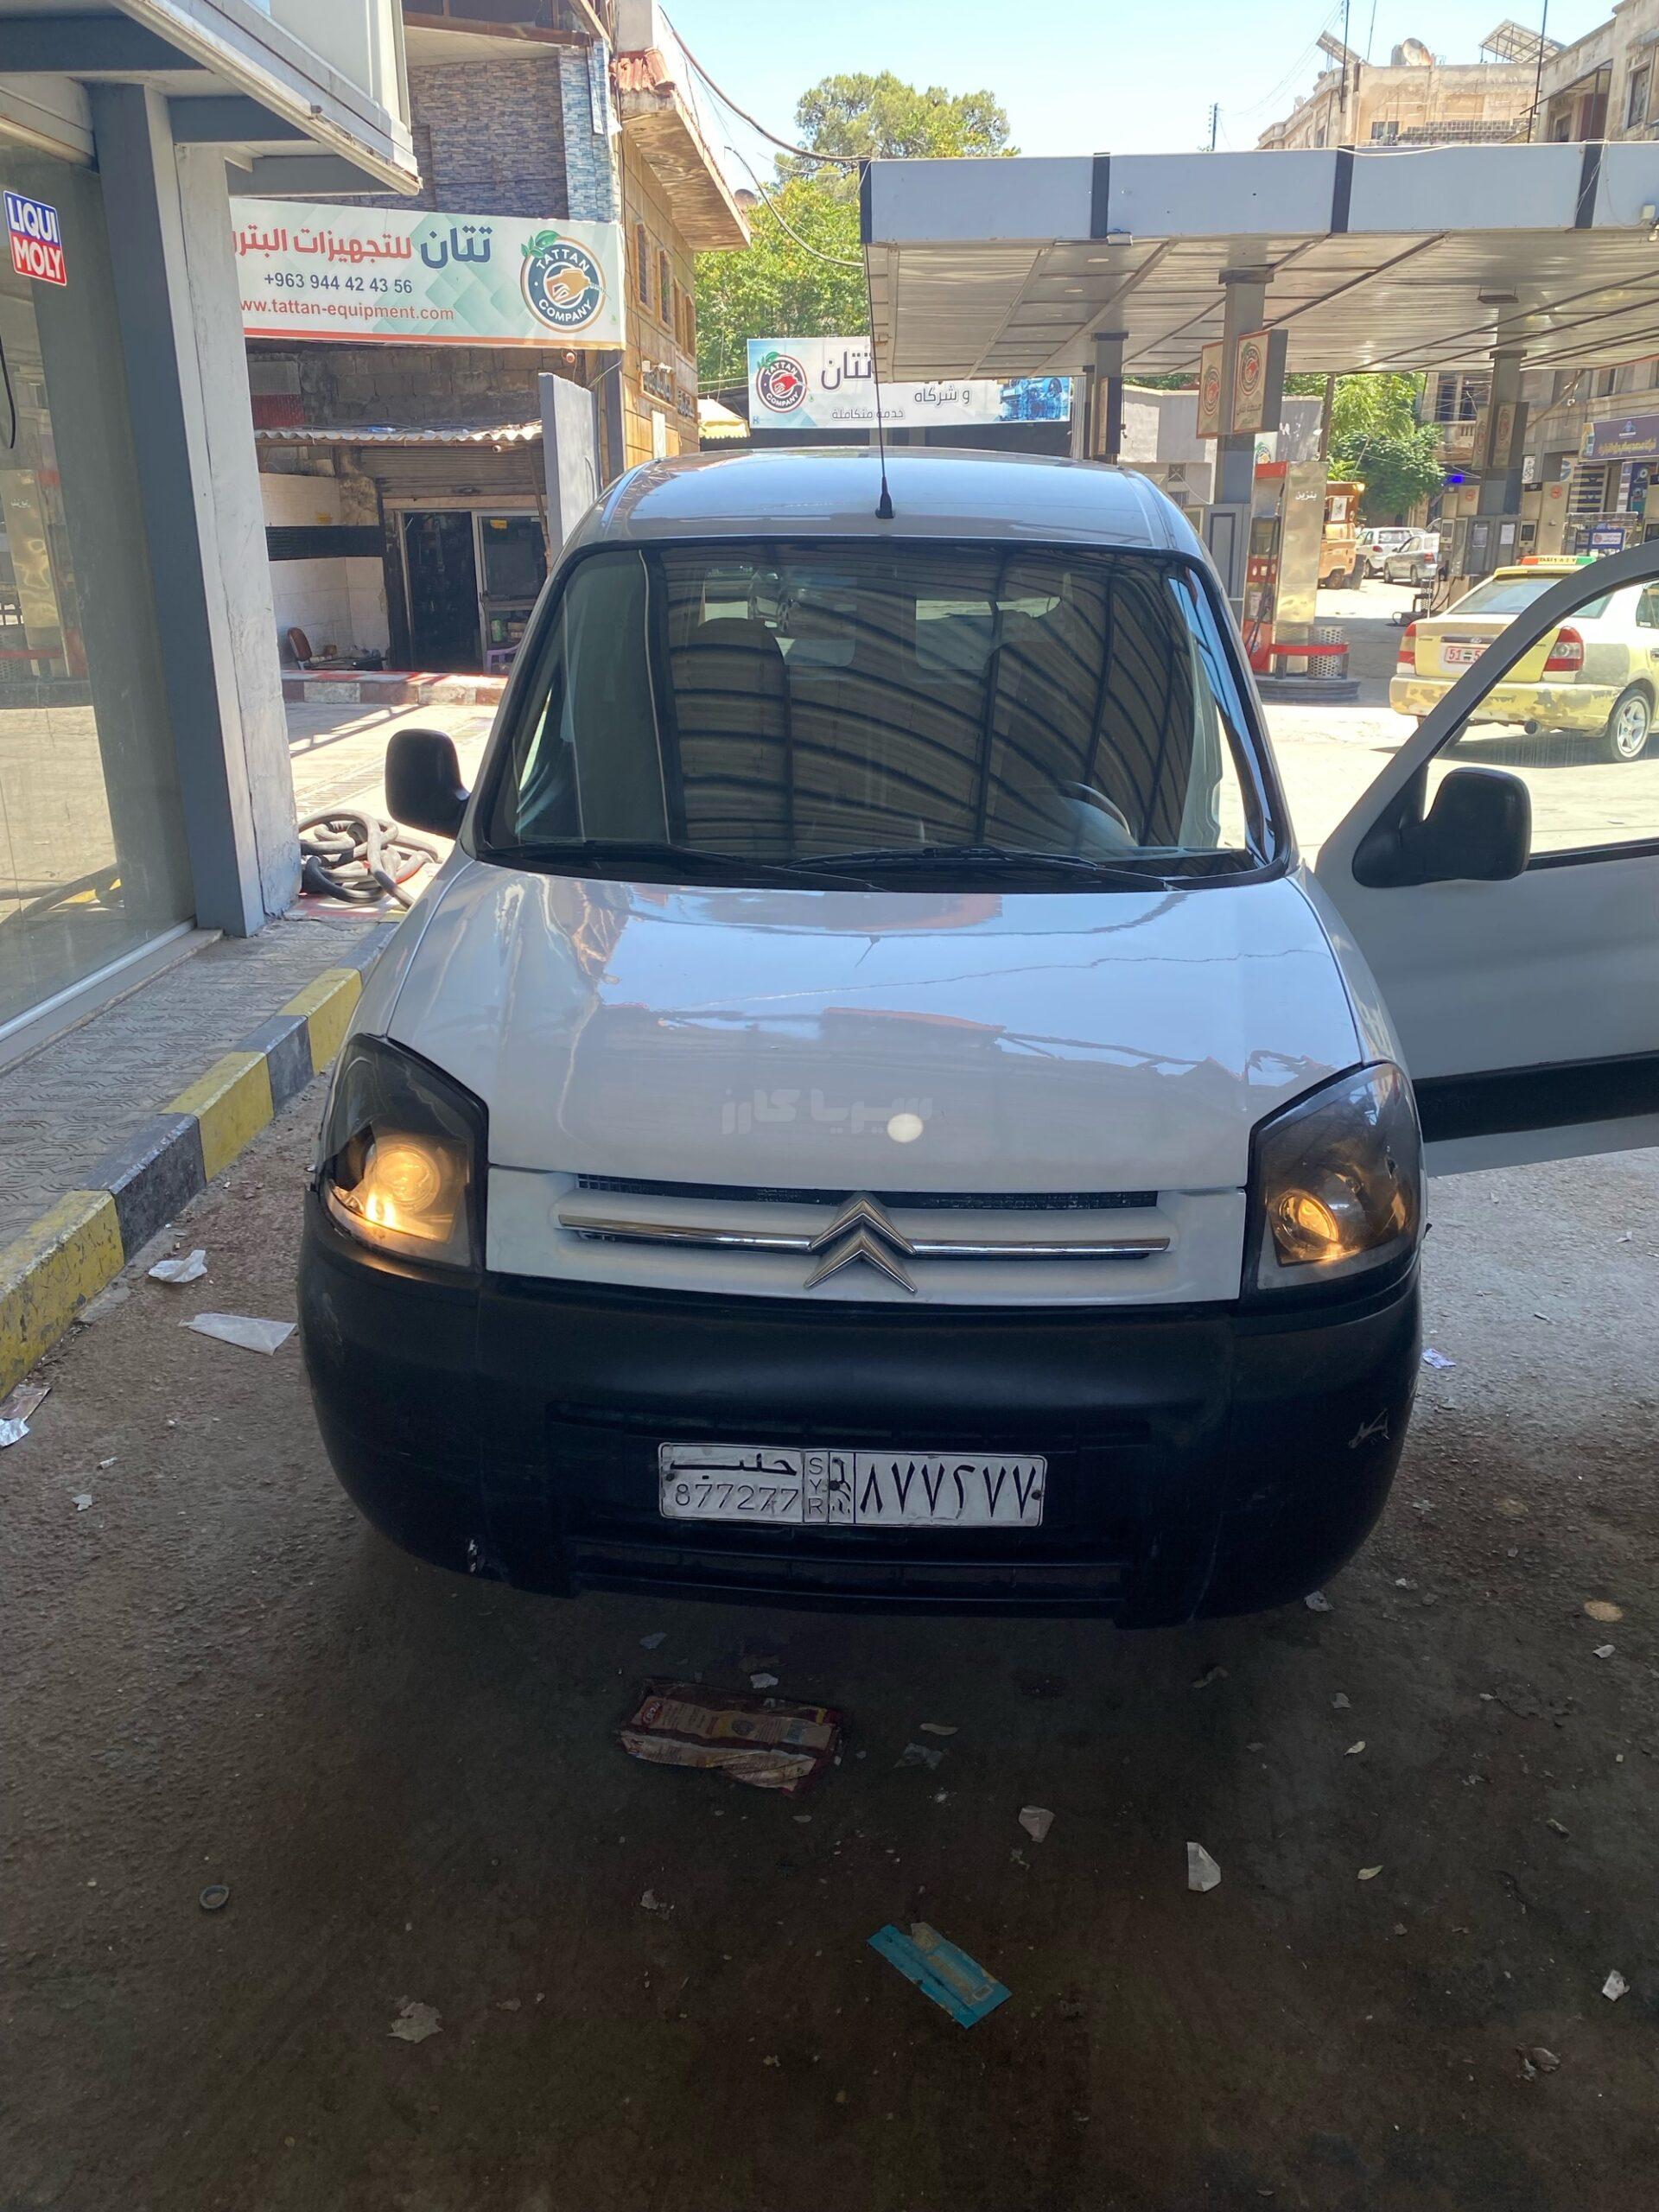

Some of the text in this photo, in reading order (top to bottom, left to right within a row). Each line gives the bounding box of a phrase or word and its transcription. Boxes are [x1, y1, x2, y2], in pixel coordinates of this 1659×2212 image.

[7, 197, 59, 243] LIQUI
[293, 228, 412, 263] للتجهيزات
[421, 225, 493, 269] تتان
[13, 237, 61, 279] MOLY
[536, 249, 590, 271] TATTAN
[264, 272, 412, 293] +963 944 42 43 56
[538, 299, 592, 321] COMPANY
[765, 362, 798, 376] TATTAN
[766, 391, 799, 406] COMPANY
[914, 385, 970, 406] و شركاه
[831, 408, 873, 419] متكاملة
[1449, 649, 1462, 660] 51
[670, 1452, 798, 1480] حلب
[675, 1483, 799, 1512] 877277
[860, 1460, 1037, 1519] ٨٧٧٢٧٧
